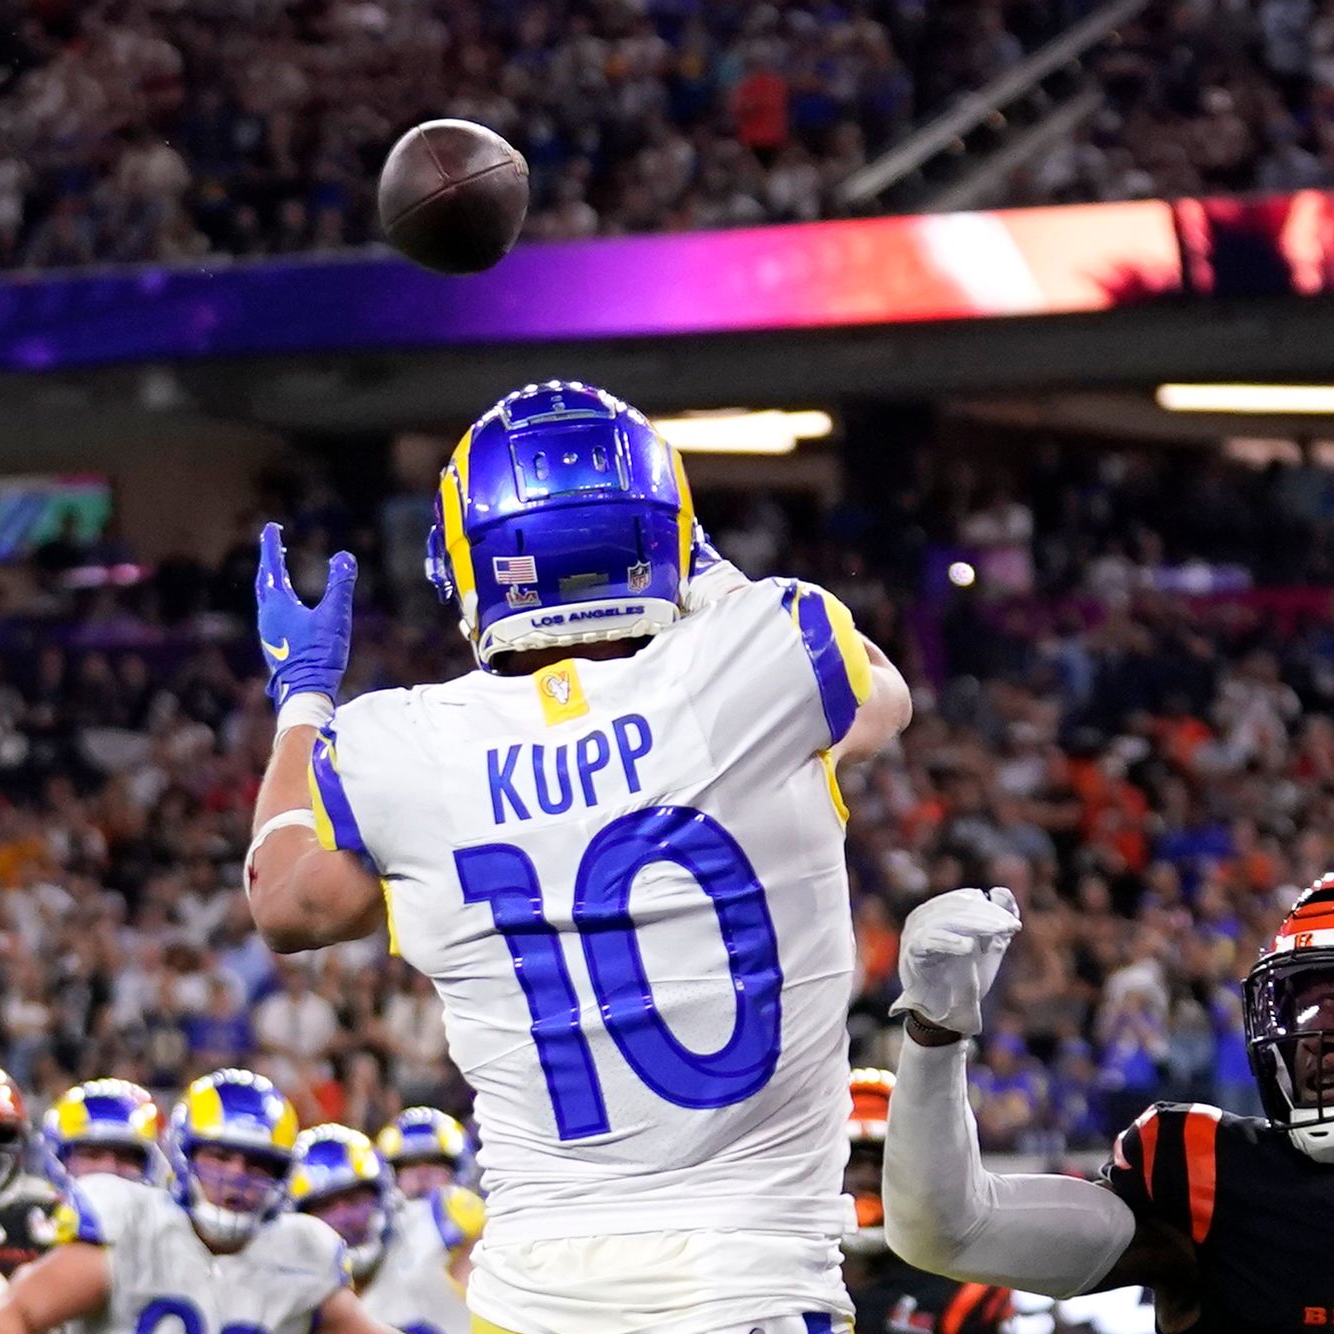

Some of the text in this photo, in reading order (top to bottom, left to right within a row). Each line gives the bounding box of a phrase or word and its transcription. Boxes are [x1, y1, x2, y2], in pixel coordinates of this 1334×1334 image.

[531, 605, 645, 628] LOS ANGELES
[486, 713, 653, 824] KUPP
[453, 804, 784, 1142] 10
